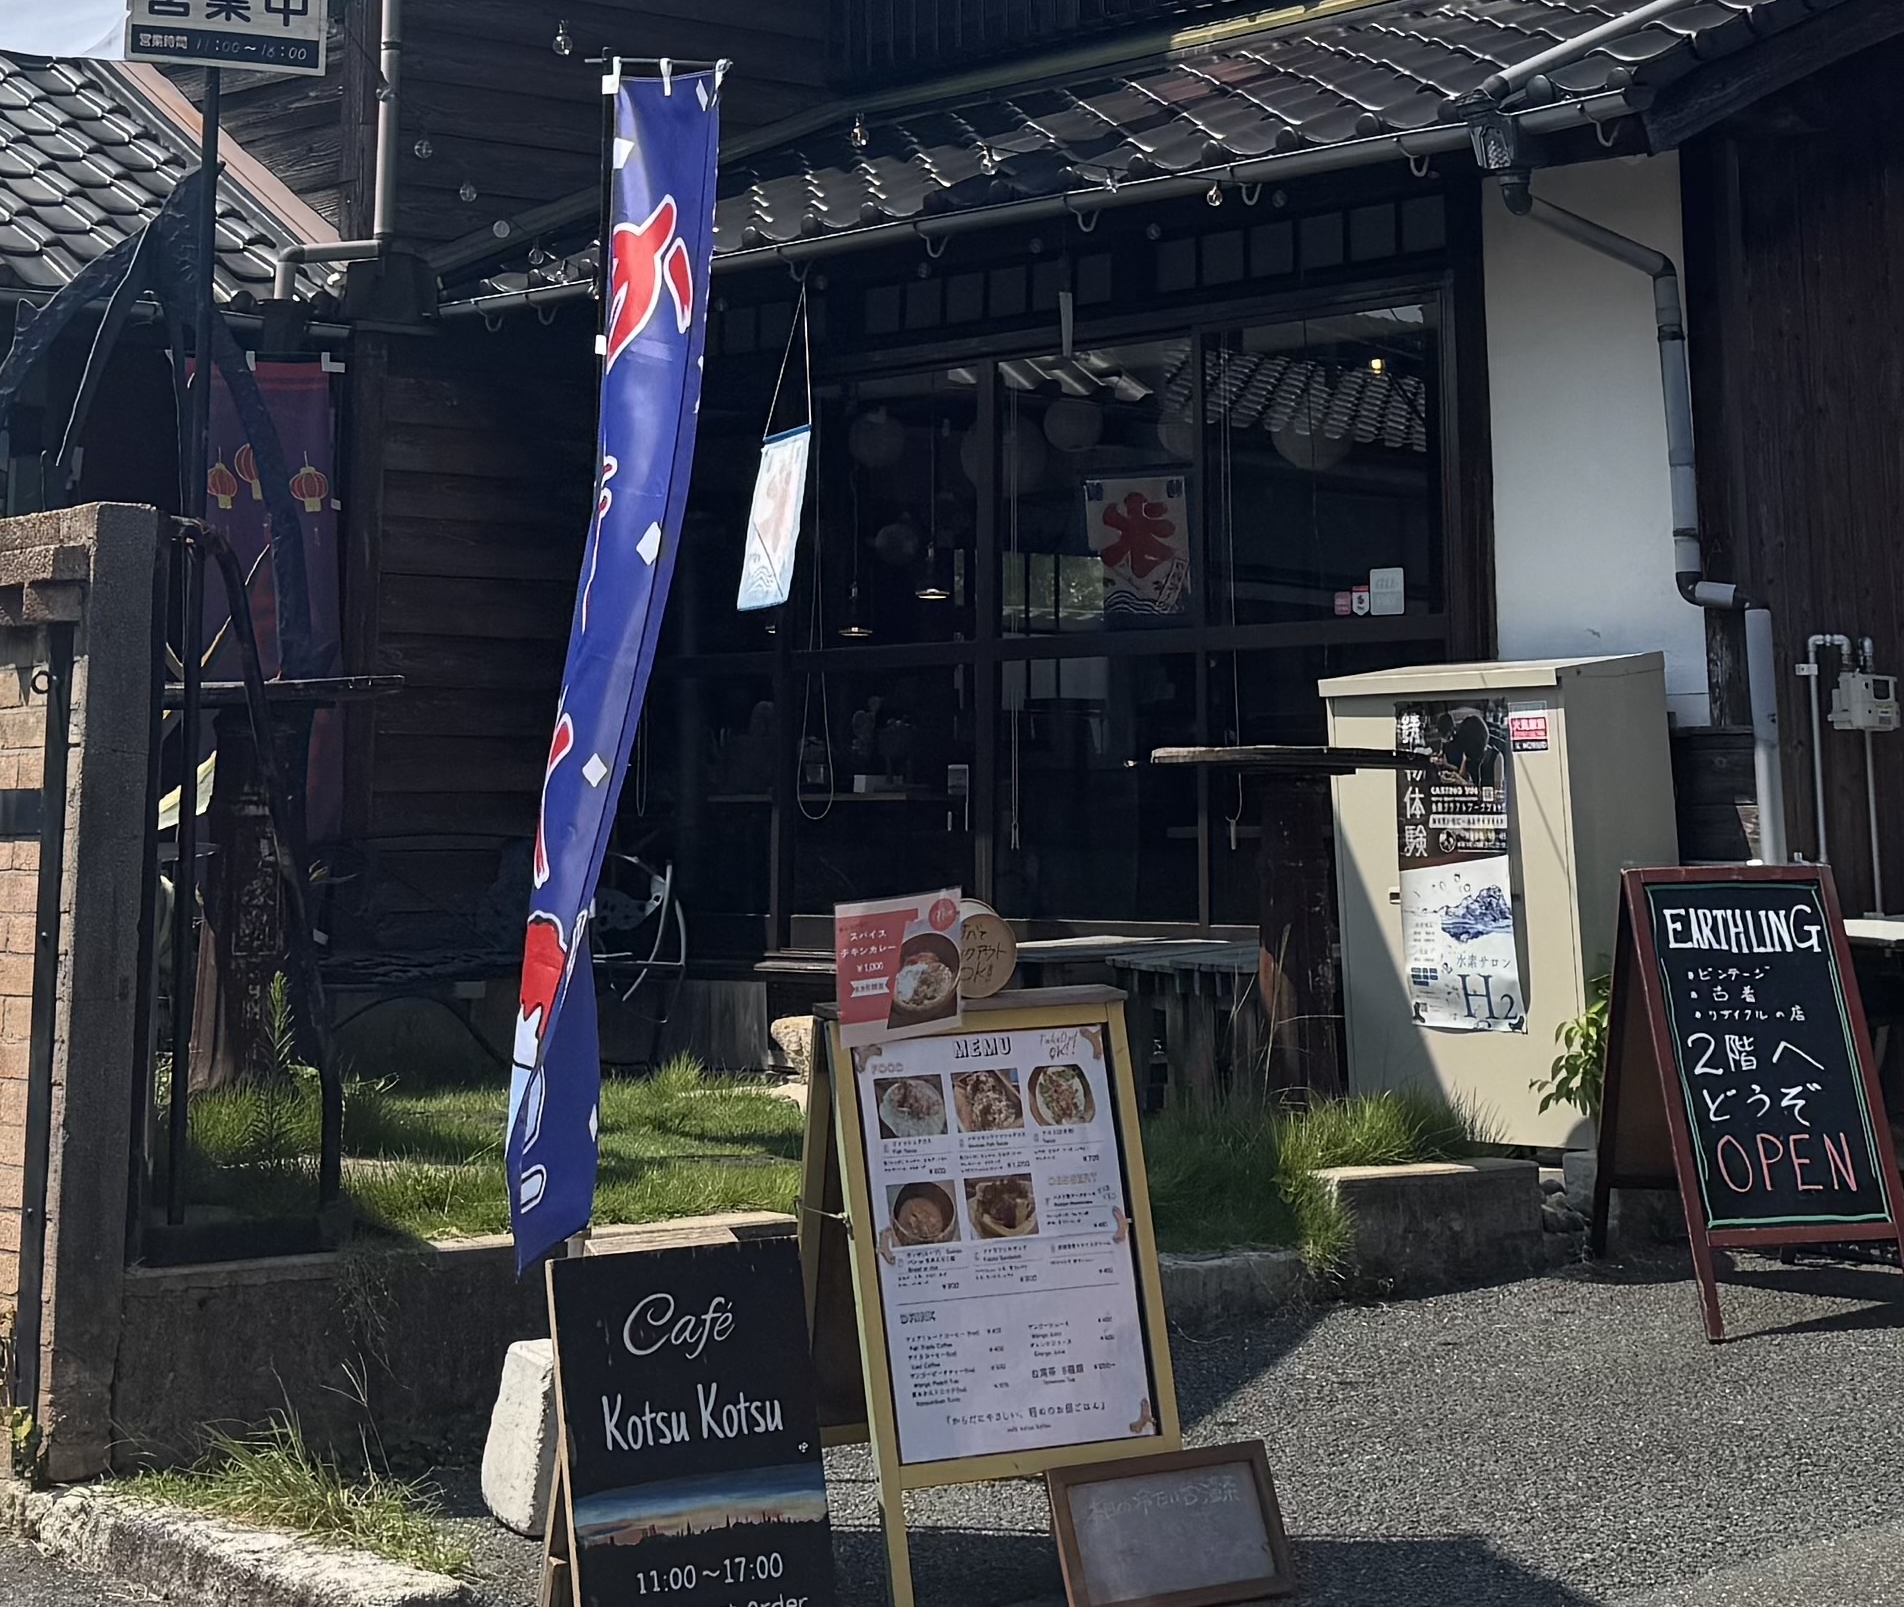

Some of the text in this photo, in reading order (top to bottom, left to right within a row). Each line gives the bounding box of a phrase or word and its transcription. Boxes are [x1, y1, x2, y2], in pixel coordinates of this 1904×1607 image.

[1100, 492, 1177, 579] 氷
[849, 929, 887, 942] スパイス
[1662, 904, 1822, 954] EARTHLING
[840, 945, 897, 959] チキンカレー
[1457, 953, 1512, 969] 水素サロン
[1697, 965, 1771, 981] ビンテージ
[1712, 984, 1756, 1003] 古着
[1687, 1032, 1825, 1076] 2階へ
[1702, 1082, 1823, 1127] どうぞ
[1716, 1131, 1858, 1193] OPEN
[623, 1292, 736, 1360] Café
[601, 1381, 784, 1452] Kotsu Kotsu
